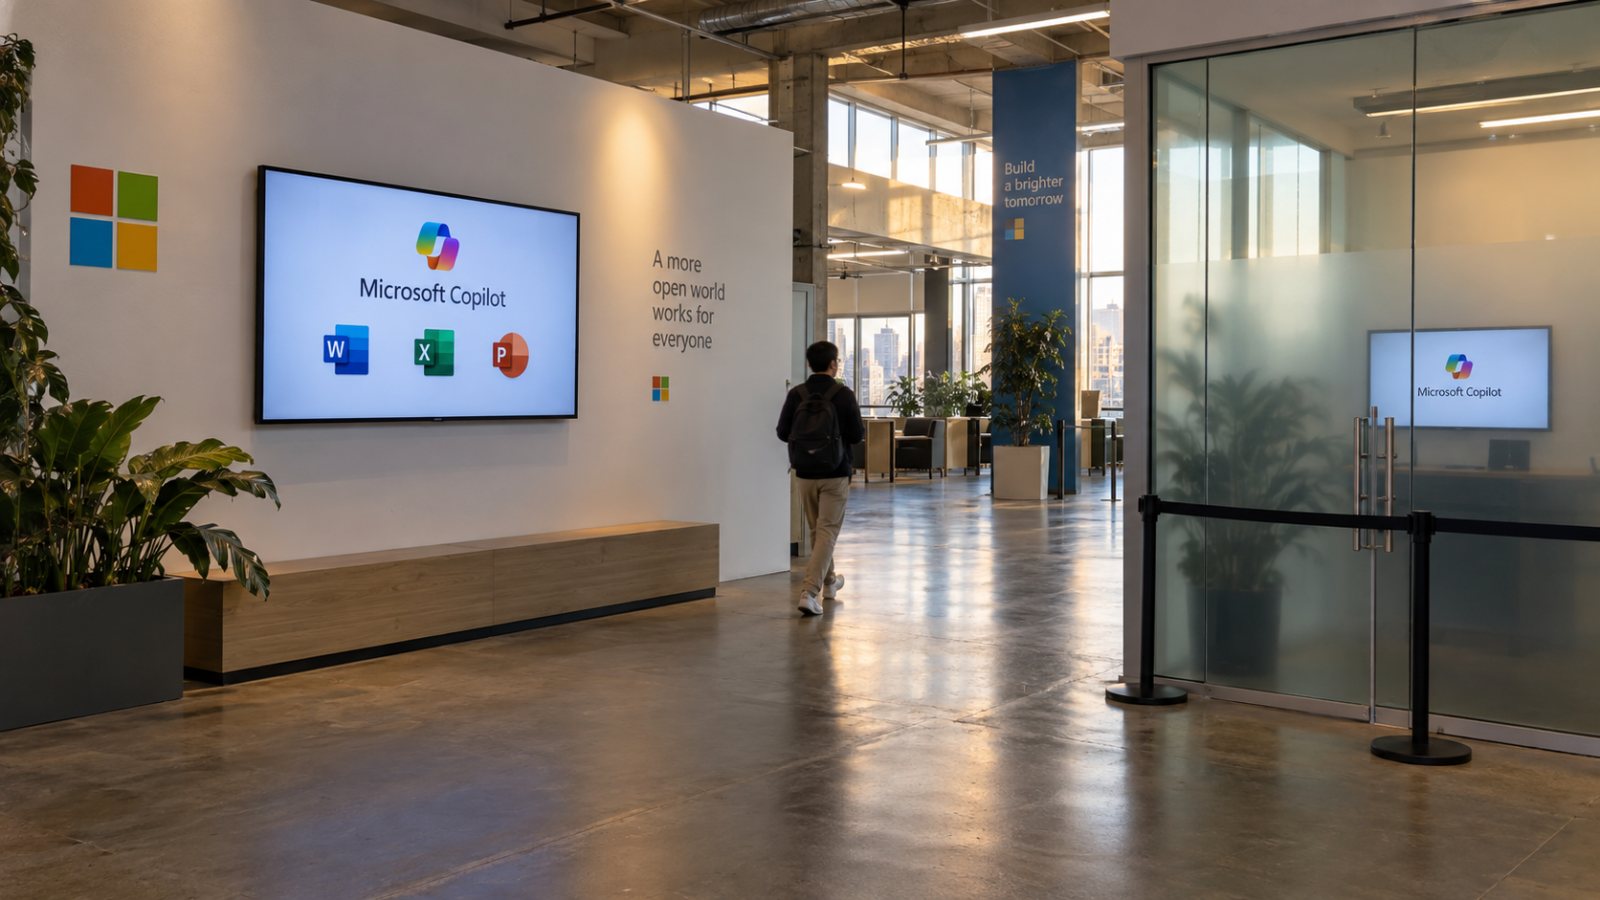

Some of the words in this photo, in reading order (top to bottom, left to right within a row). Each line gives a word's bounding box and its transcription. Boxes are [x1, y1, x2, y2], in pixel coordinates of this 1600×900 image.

[1005, 160, 1035, 175] Build
[1004, 182, 1012, 191] a
[1015, 176, 1063, 192] brighter
[1004, 194, 1064, 208] tomorrow
[652, 249, 663, 268] A
[667, 255, 702, 273] more
[359, 277, 446, 303] Microsoft
[450, 285, 507, 311] Copilot
[652, 280, 687, 300] open
[690, 282, 725, 301] world
[652, 303, 693, 323] works
[696, 305, 714, 325] for
[326, 340, 345, 359] W
[652, 332, 713, 353] everyone
[418, 343, 431, 361] X
[496, 346, 507, 363] P
[1417, 386, 1464, 397] Microsoft
[1466, 386, 1502, 399] Copilot
